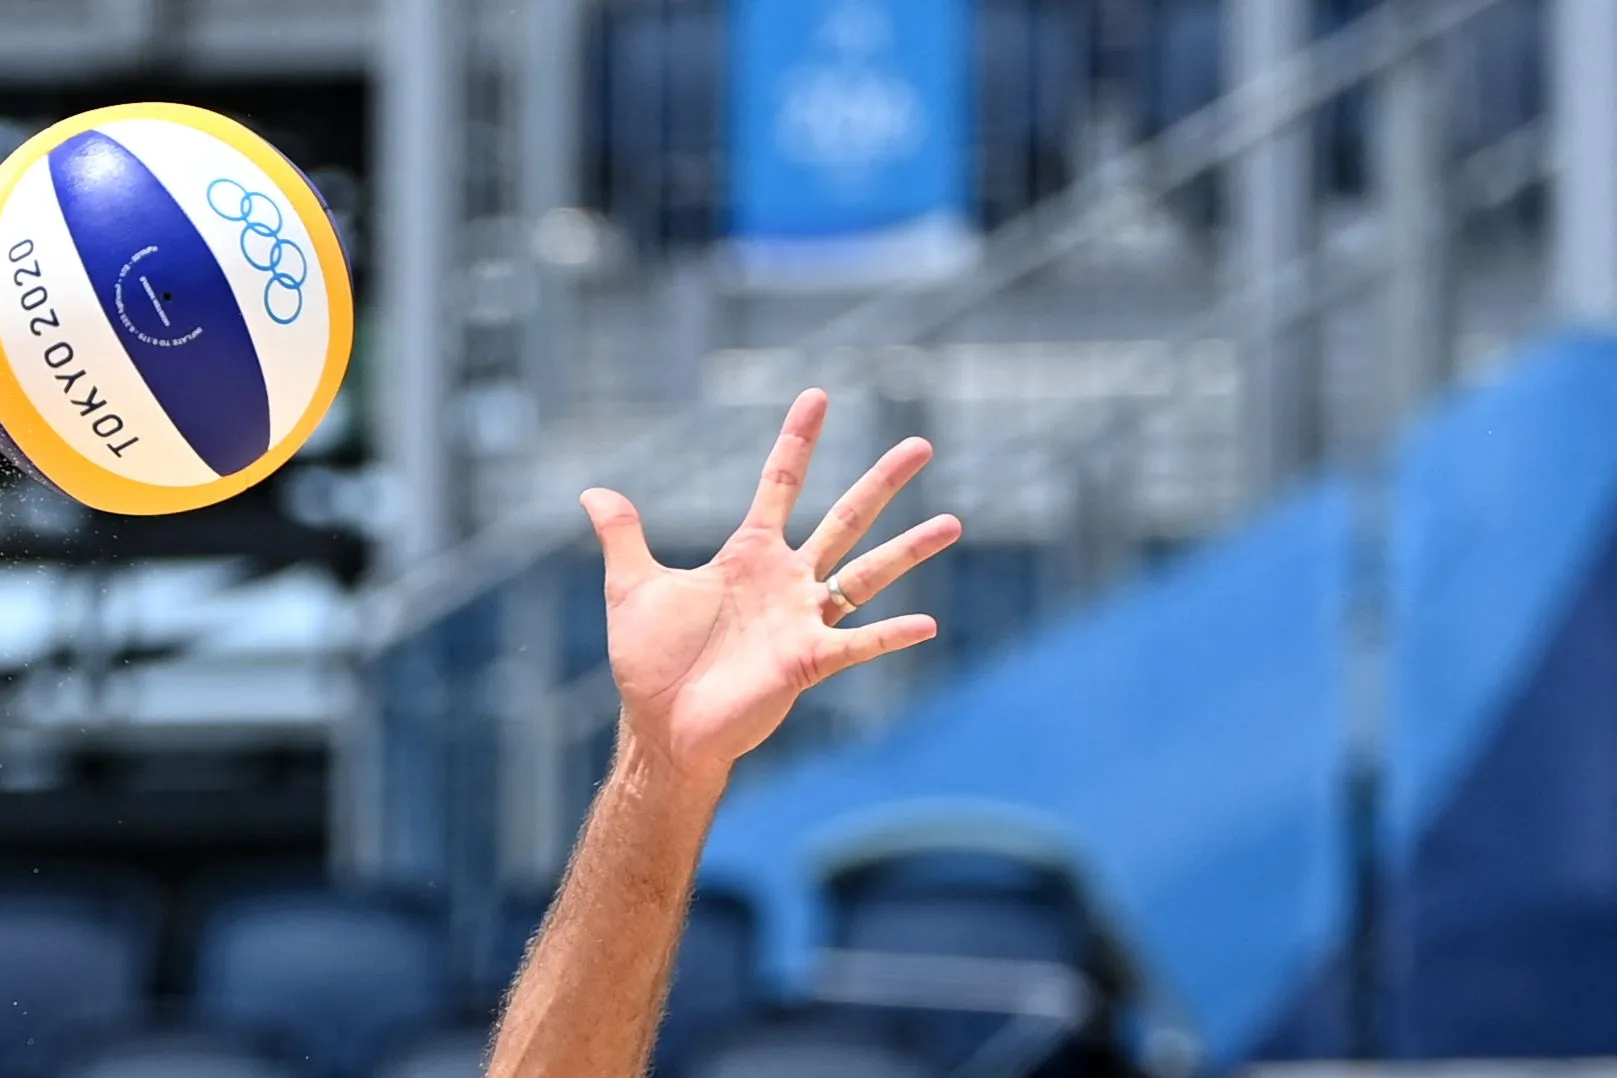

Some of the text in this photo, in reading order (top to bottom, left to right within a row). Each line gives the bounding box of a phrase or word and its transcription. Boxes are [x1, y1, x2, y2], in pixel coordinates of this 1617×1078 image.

[8, 238, 61, 337] 2020
[158, 339, 171, 347] TO
[44, 340, 140, 458] TOKYO
